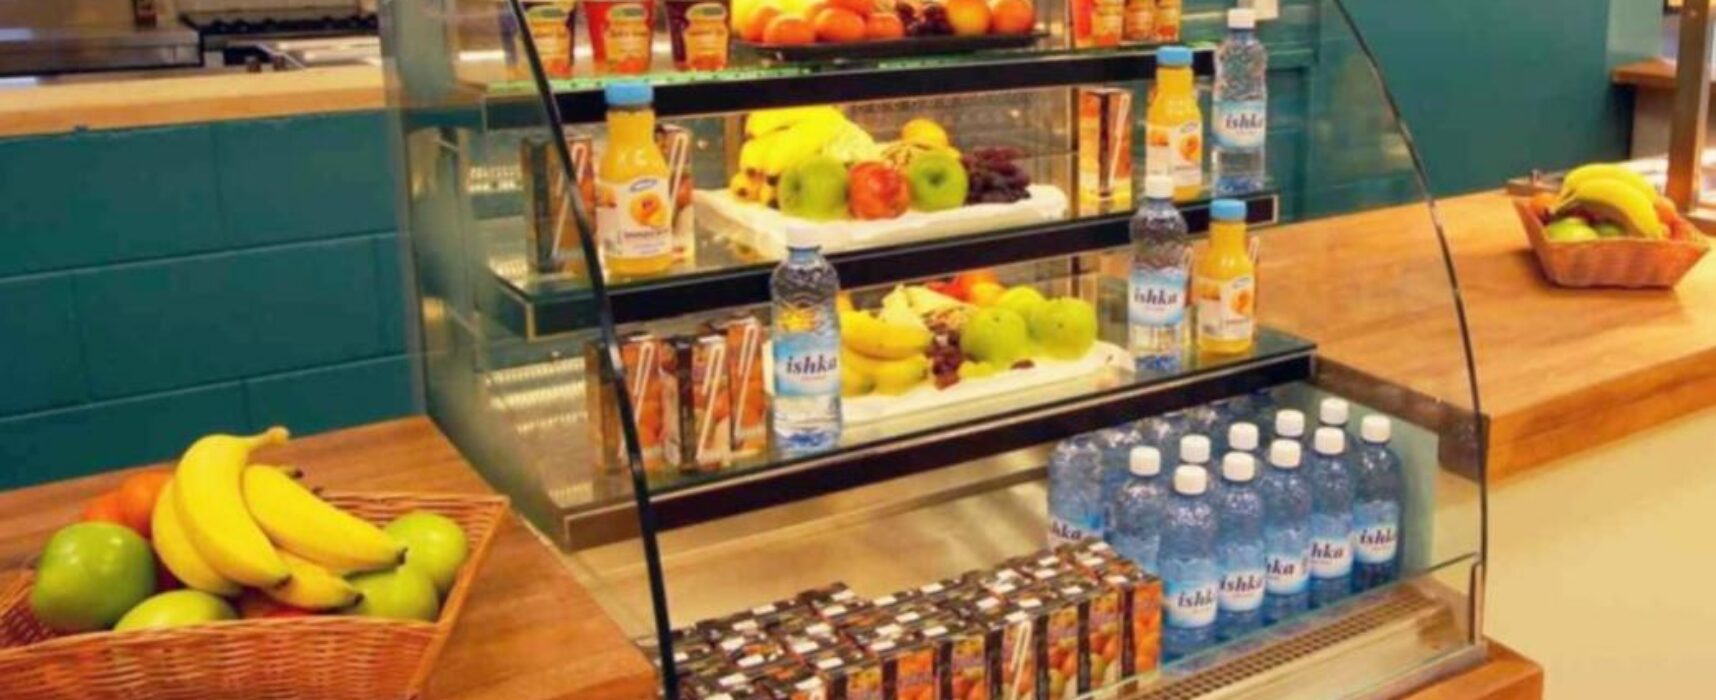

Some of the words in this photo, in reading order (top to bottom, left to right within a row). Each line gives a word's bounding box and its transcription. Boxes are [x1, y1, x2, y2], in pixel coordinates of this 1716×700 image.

[1134, 287, 1178, 305] ishka
[786, 353, 838, 374] ishka
[1360, 528, 1396, 545] ishk
[1311, 541, 1344, 559] hka
[1178, 590, 1216, 607] ishk
